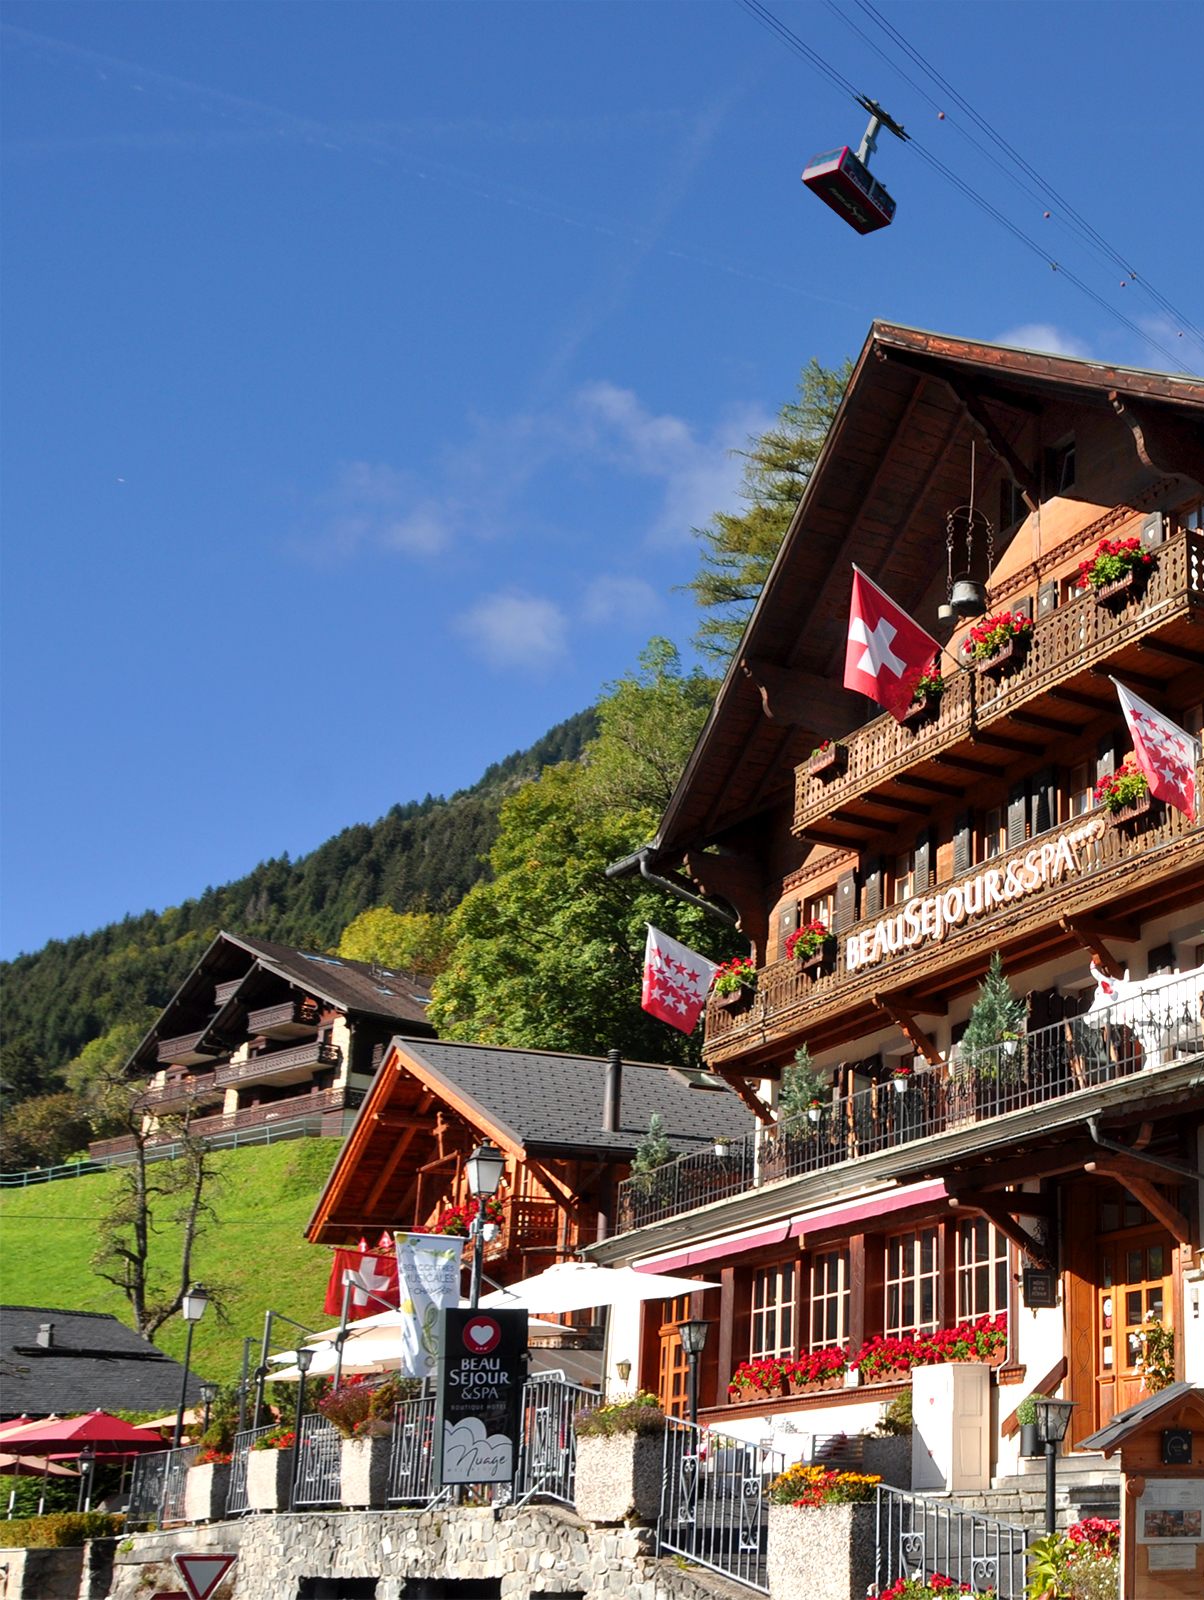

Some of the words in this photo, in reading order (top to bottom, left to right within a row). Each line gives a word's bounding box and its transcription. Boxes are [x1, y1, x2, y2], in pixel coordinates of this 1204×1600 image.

[402, 1263, 454, 1272] RENCONTRES
[461, 1357, 500, 1370] BEAU
[448, 1369, 511, 1388] SEJOUR
[460, 1386, 499, 1400] &SPA
[446, 1444, 508, 1477] Nuage
